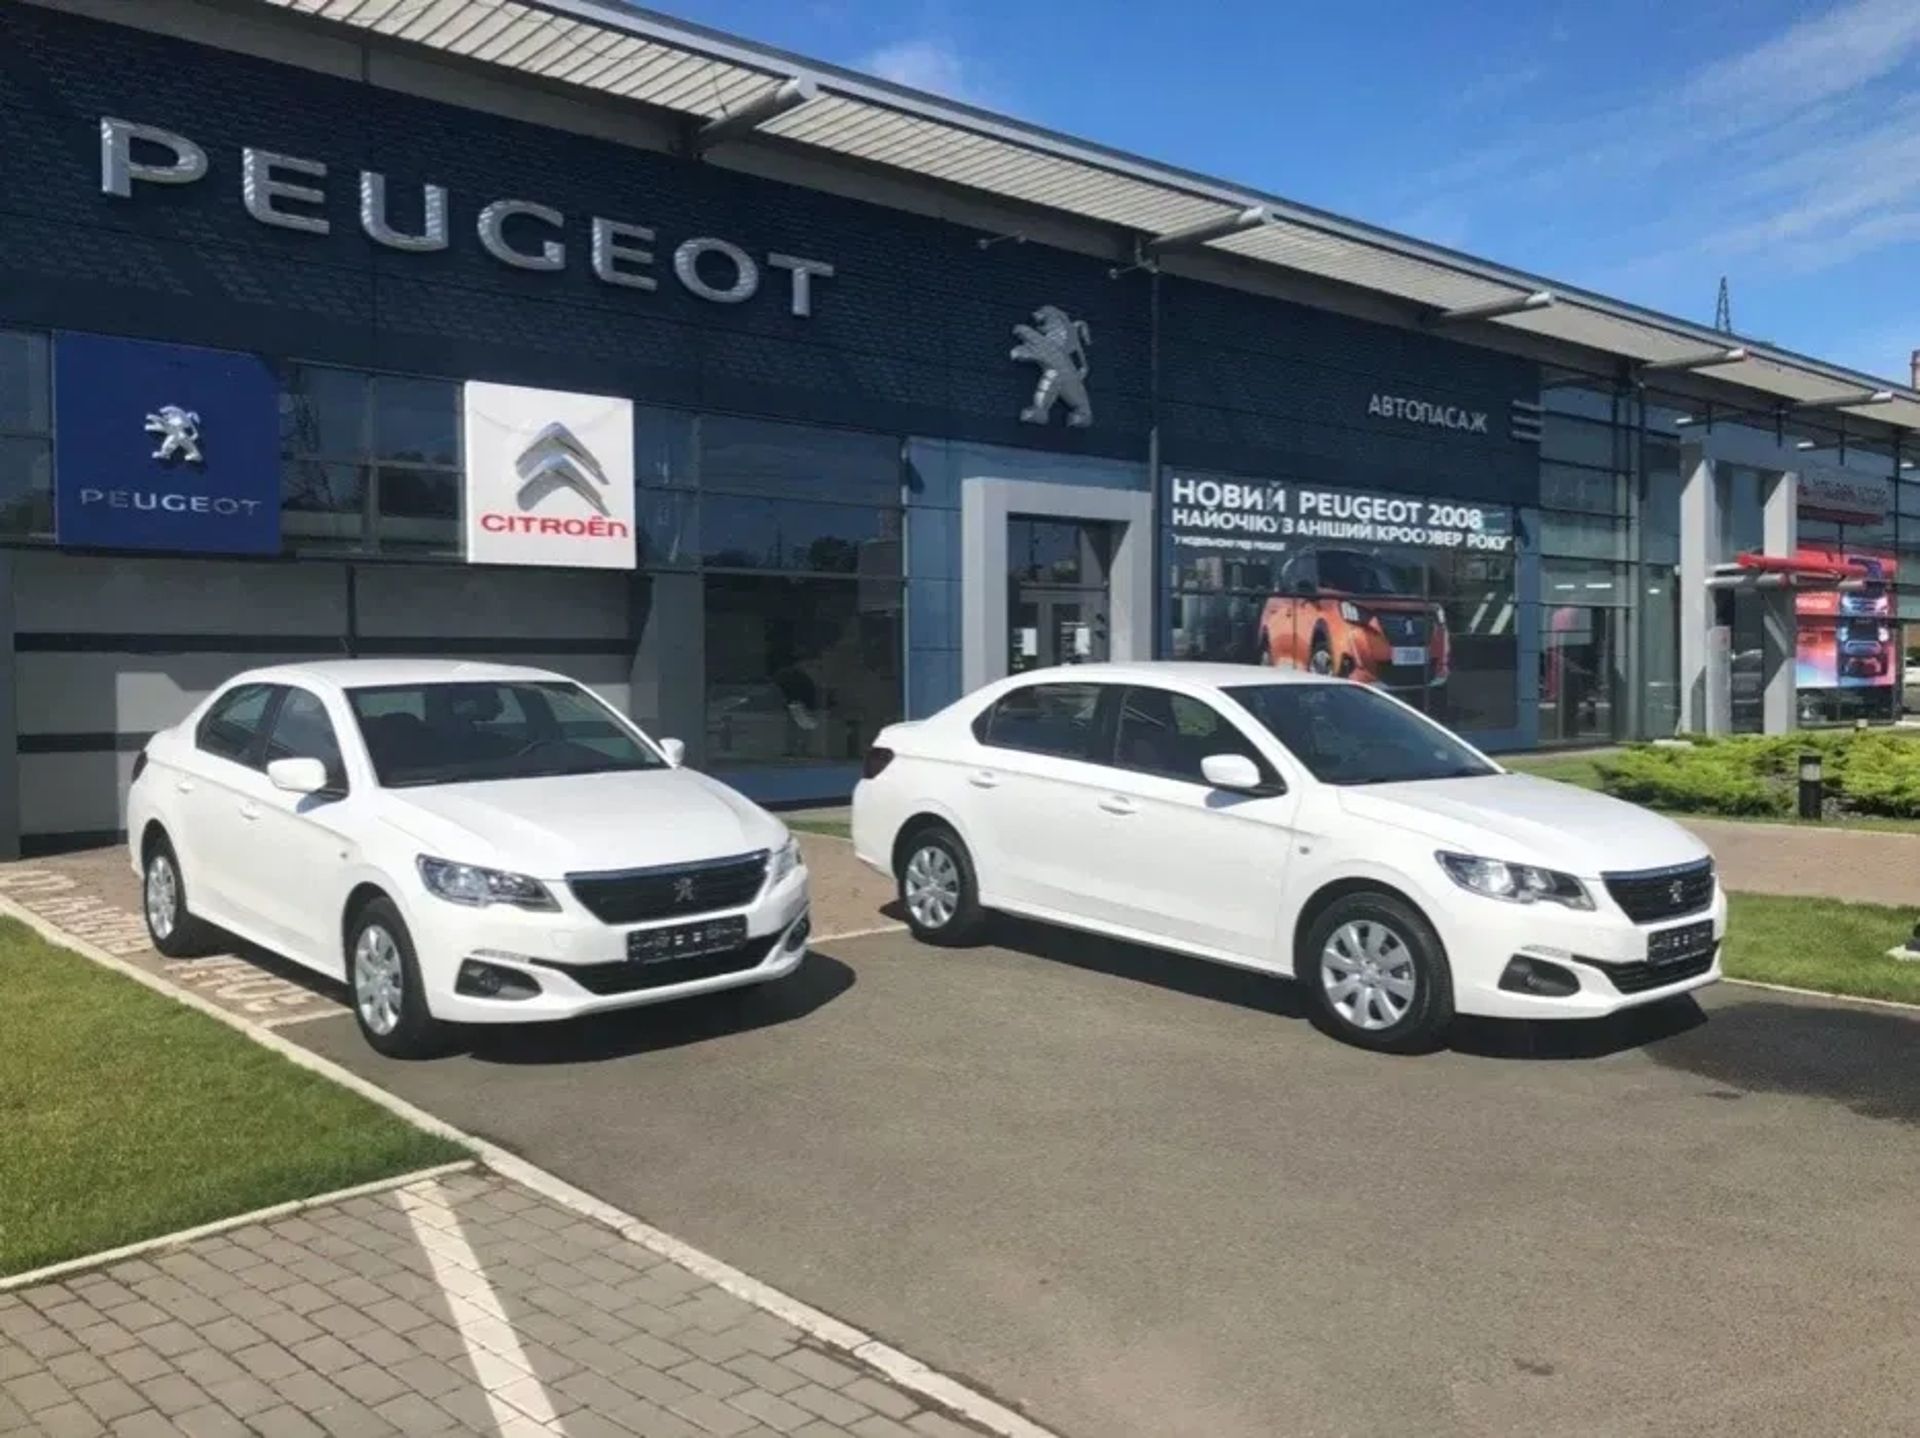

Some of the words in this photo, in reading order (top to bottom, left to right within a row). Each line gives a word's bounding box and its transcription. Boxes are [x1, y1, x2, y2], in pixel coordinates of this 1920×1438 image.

[101, 117, 834, 316] PEUGEOT
[1368, 393, 1488, 433] АВТОПАСАЖ
[80, 488, 261, 515] PEUGEOT
[1172, 478, 1286, 512] НОВИЙ
[1300, 490, 1422, 523] PEUGEOT
[1428, 503, 1482, 530] 2008
[481, 515, 628, 538] CITROËN
